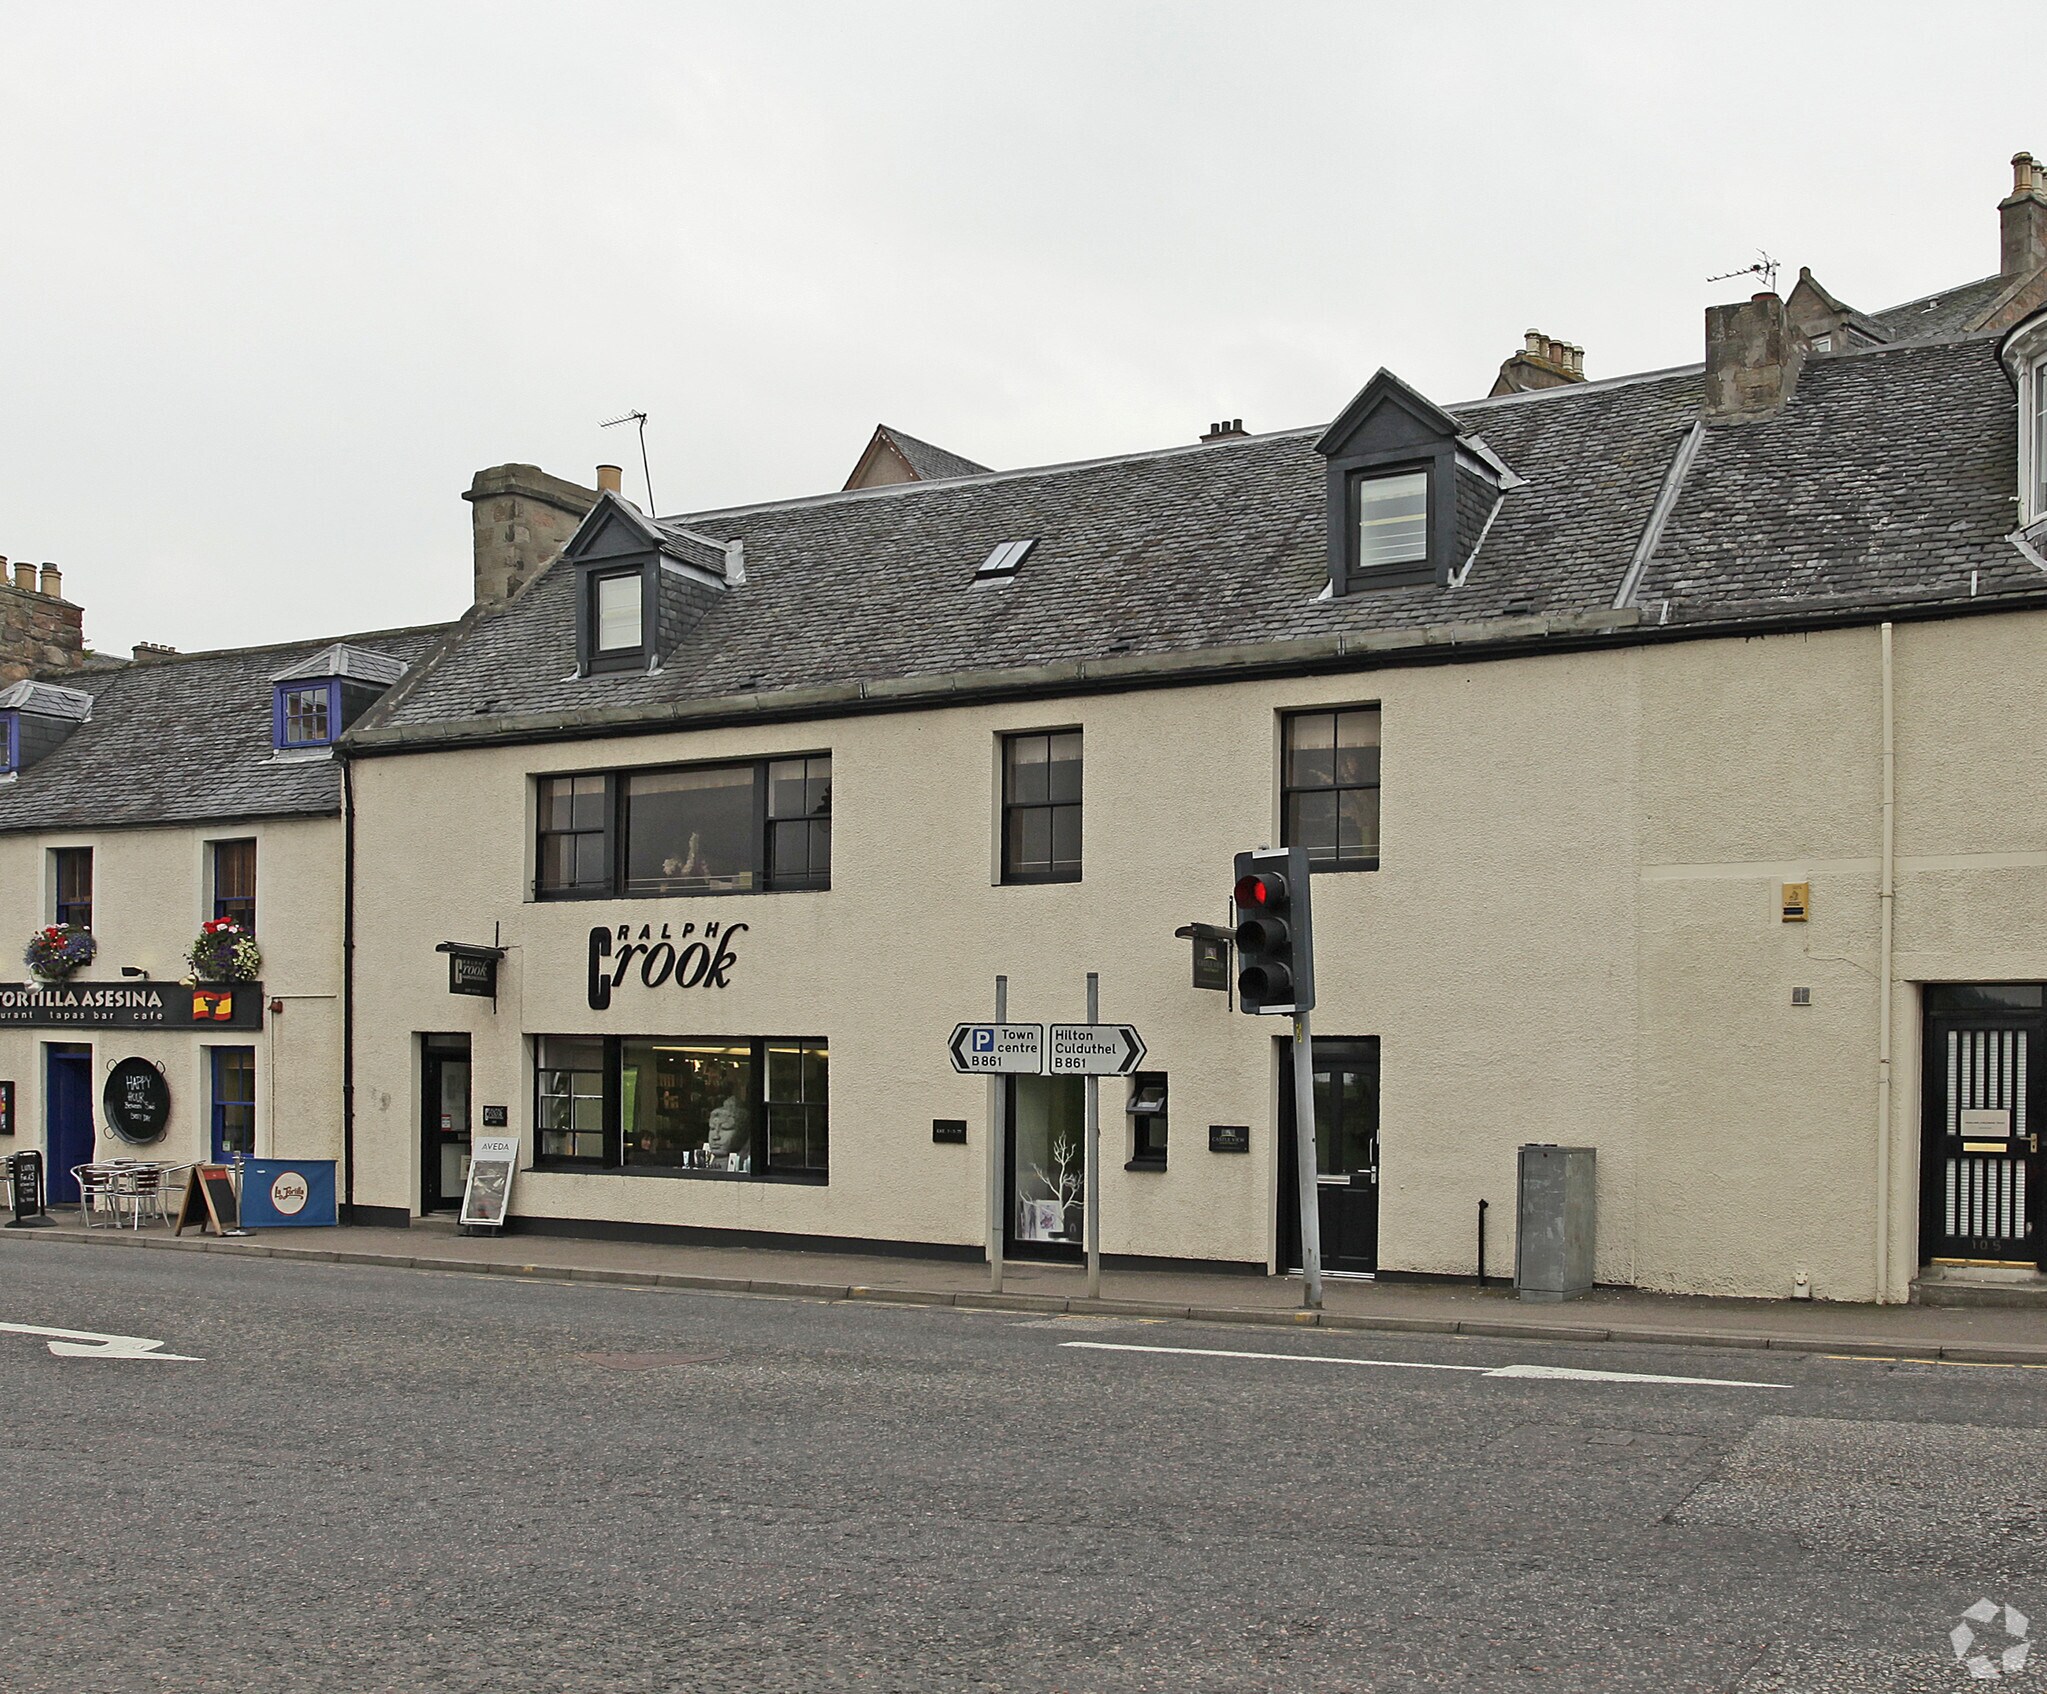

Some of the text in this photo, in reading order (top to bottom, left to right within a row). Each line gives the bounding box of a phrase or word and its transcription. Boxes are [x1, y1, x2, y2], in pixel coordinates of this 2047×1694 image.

[617, 922, 720, 940] RALPH
[455, 959, 491, 984] Crook
[588, 923, 749, 1010] Crook
[0, 990, 163, 1008] ORTILLA ASESINA
[50, 1011, 85, 1020] tapas
[94, 1011, 114, 1019] bar
[133, 1011, 163, 1020] cafe
[1001, 1029, 1034, 1040] Town
[1055, 1030, 1093, 1041] Hilton
[997, 1043, 1038, 1053] centre
[1055, 1043, 1116, 1054] Culduthel
[125, 1075, 152, 1090] HAPPY
[481, 1143, 509, 1151] AVEDA
[283, 1186, 304, 1200] Tortilla
